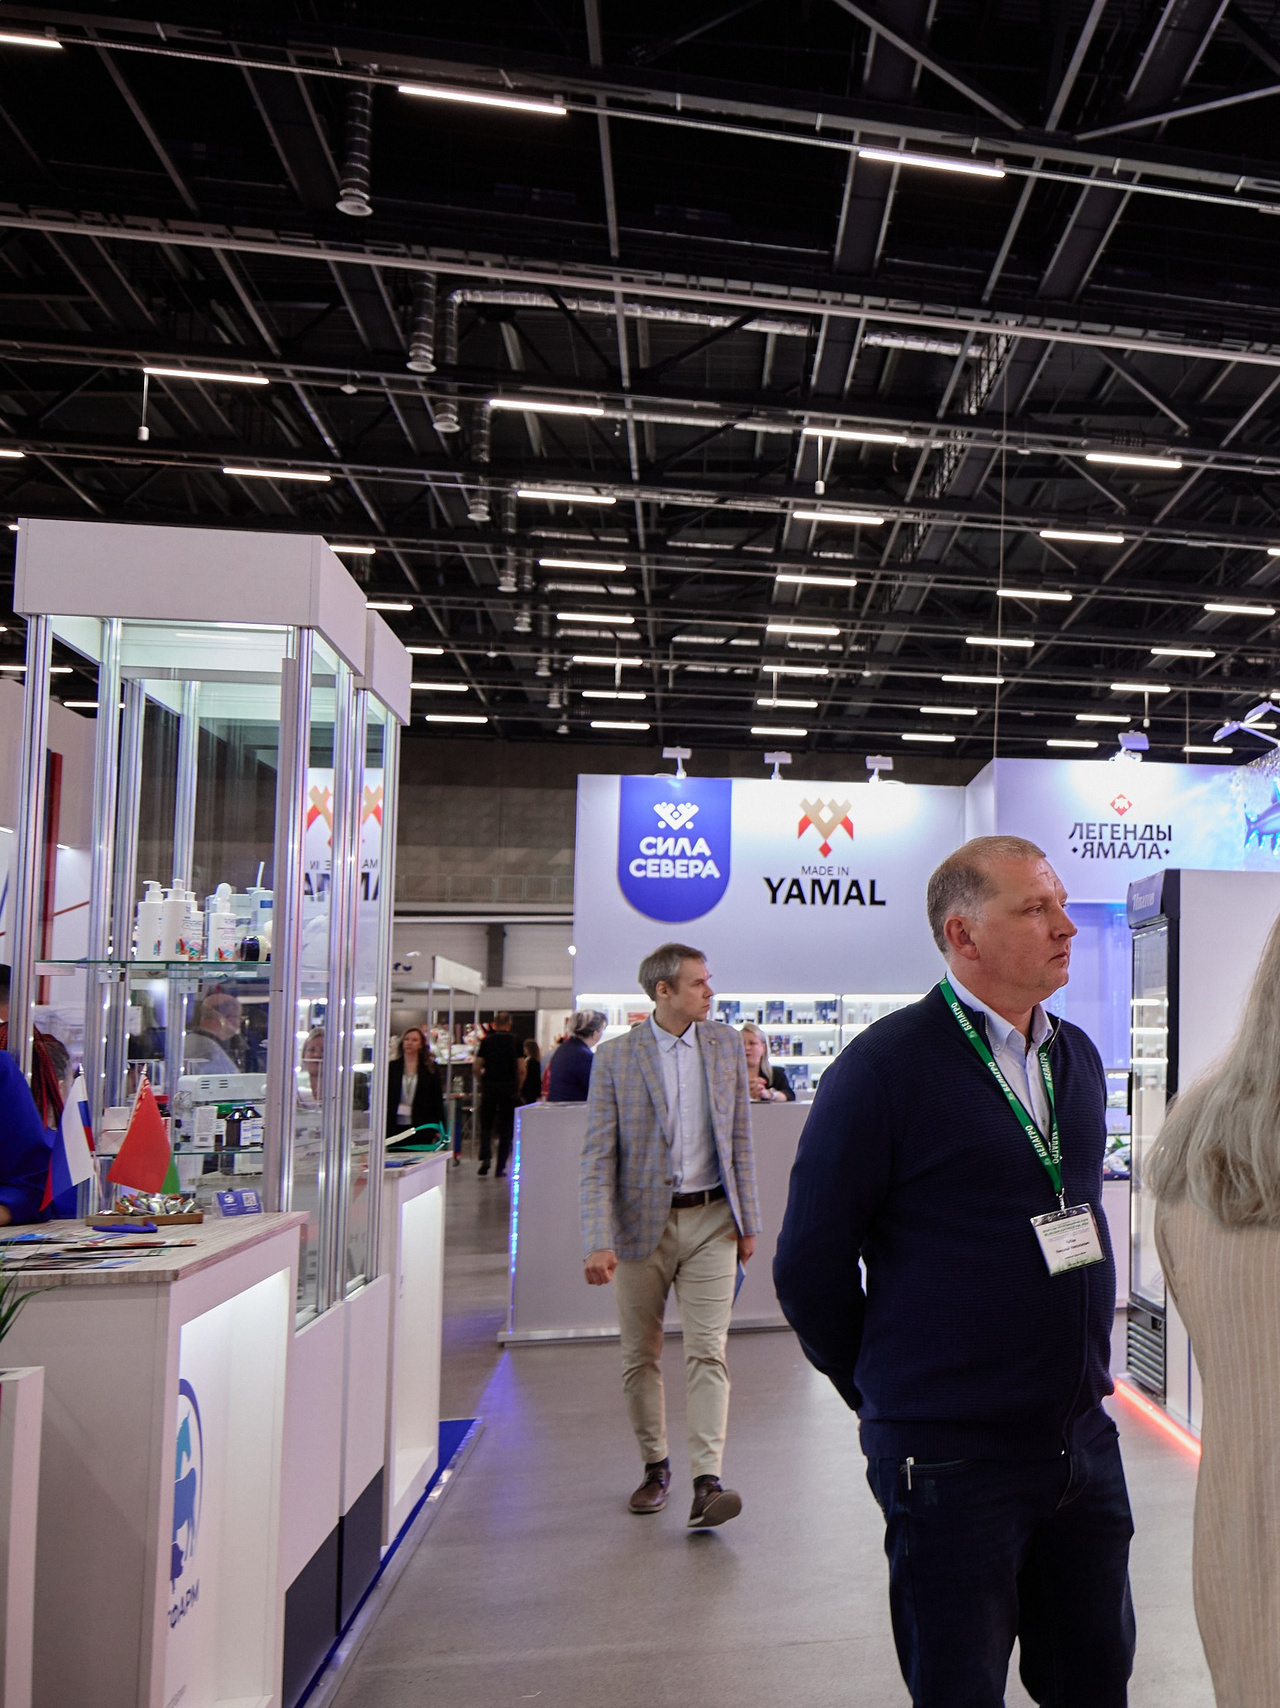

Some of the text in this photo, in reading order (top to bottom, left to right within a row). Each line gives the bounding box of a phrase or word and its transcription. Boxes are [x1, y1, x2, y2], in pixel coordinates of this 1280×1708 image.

[1068, 822, 1172, 841] ЛЕГЕНДЫ
[639, 836, 712, 857] СИЛА
[1081, 842, 1162, 859] ЯМАЛА
[629, 858, 721, 879] СЕВЕРА
[801, 865, 849, 876] MADE IN
[764, 877, 886, 906] YAMAL
[951, 1002, 973, 1032] БЕЛАГРО
[988, 1061, 1011, 1094] БЕЛАГРО
[1025, 1125, 1048, 1158] БЕЛАГРО
